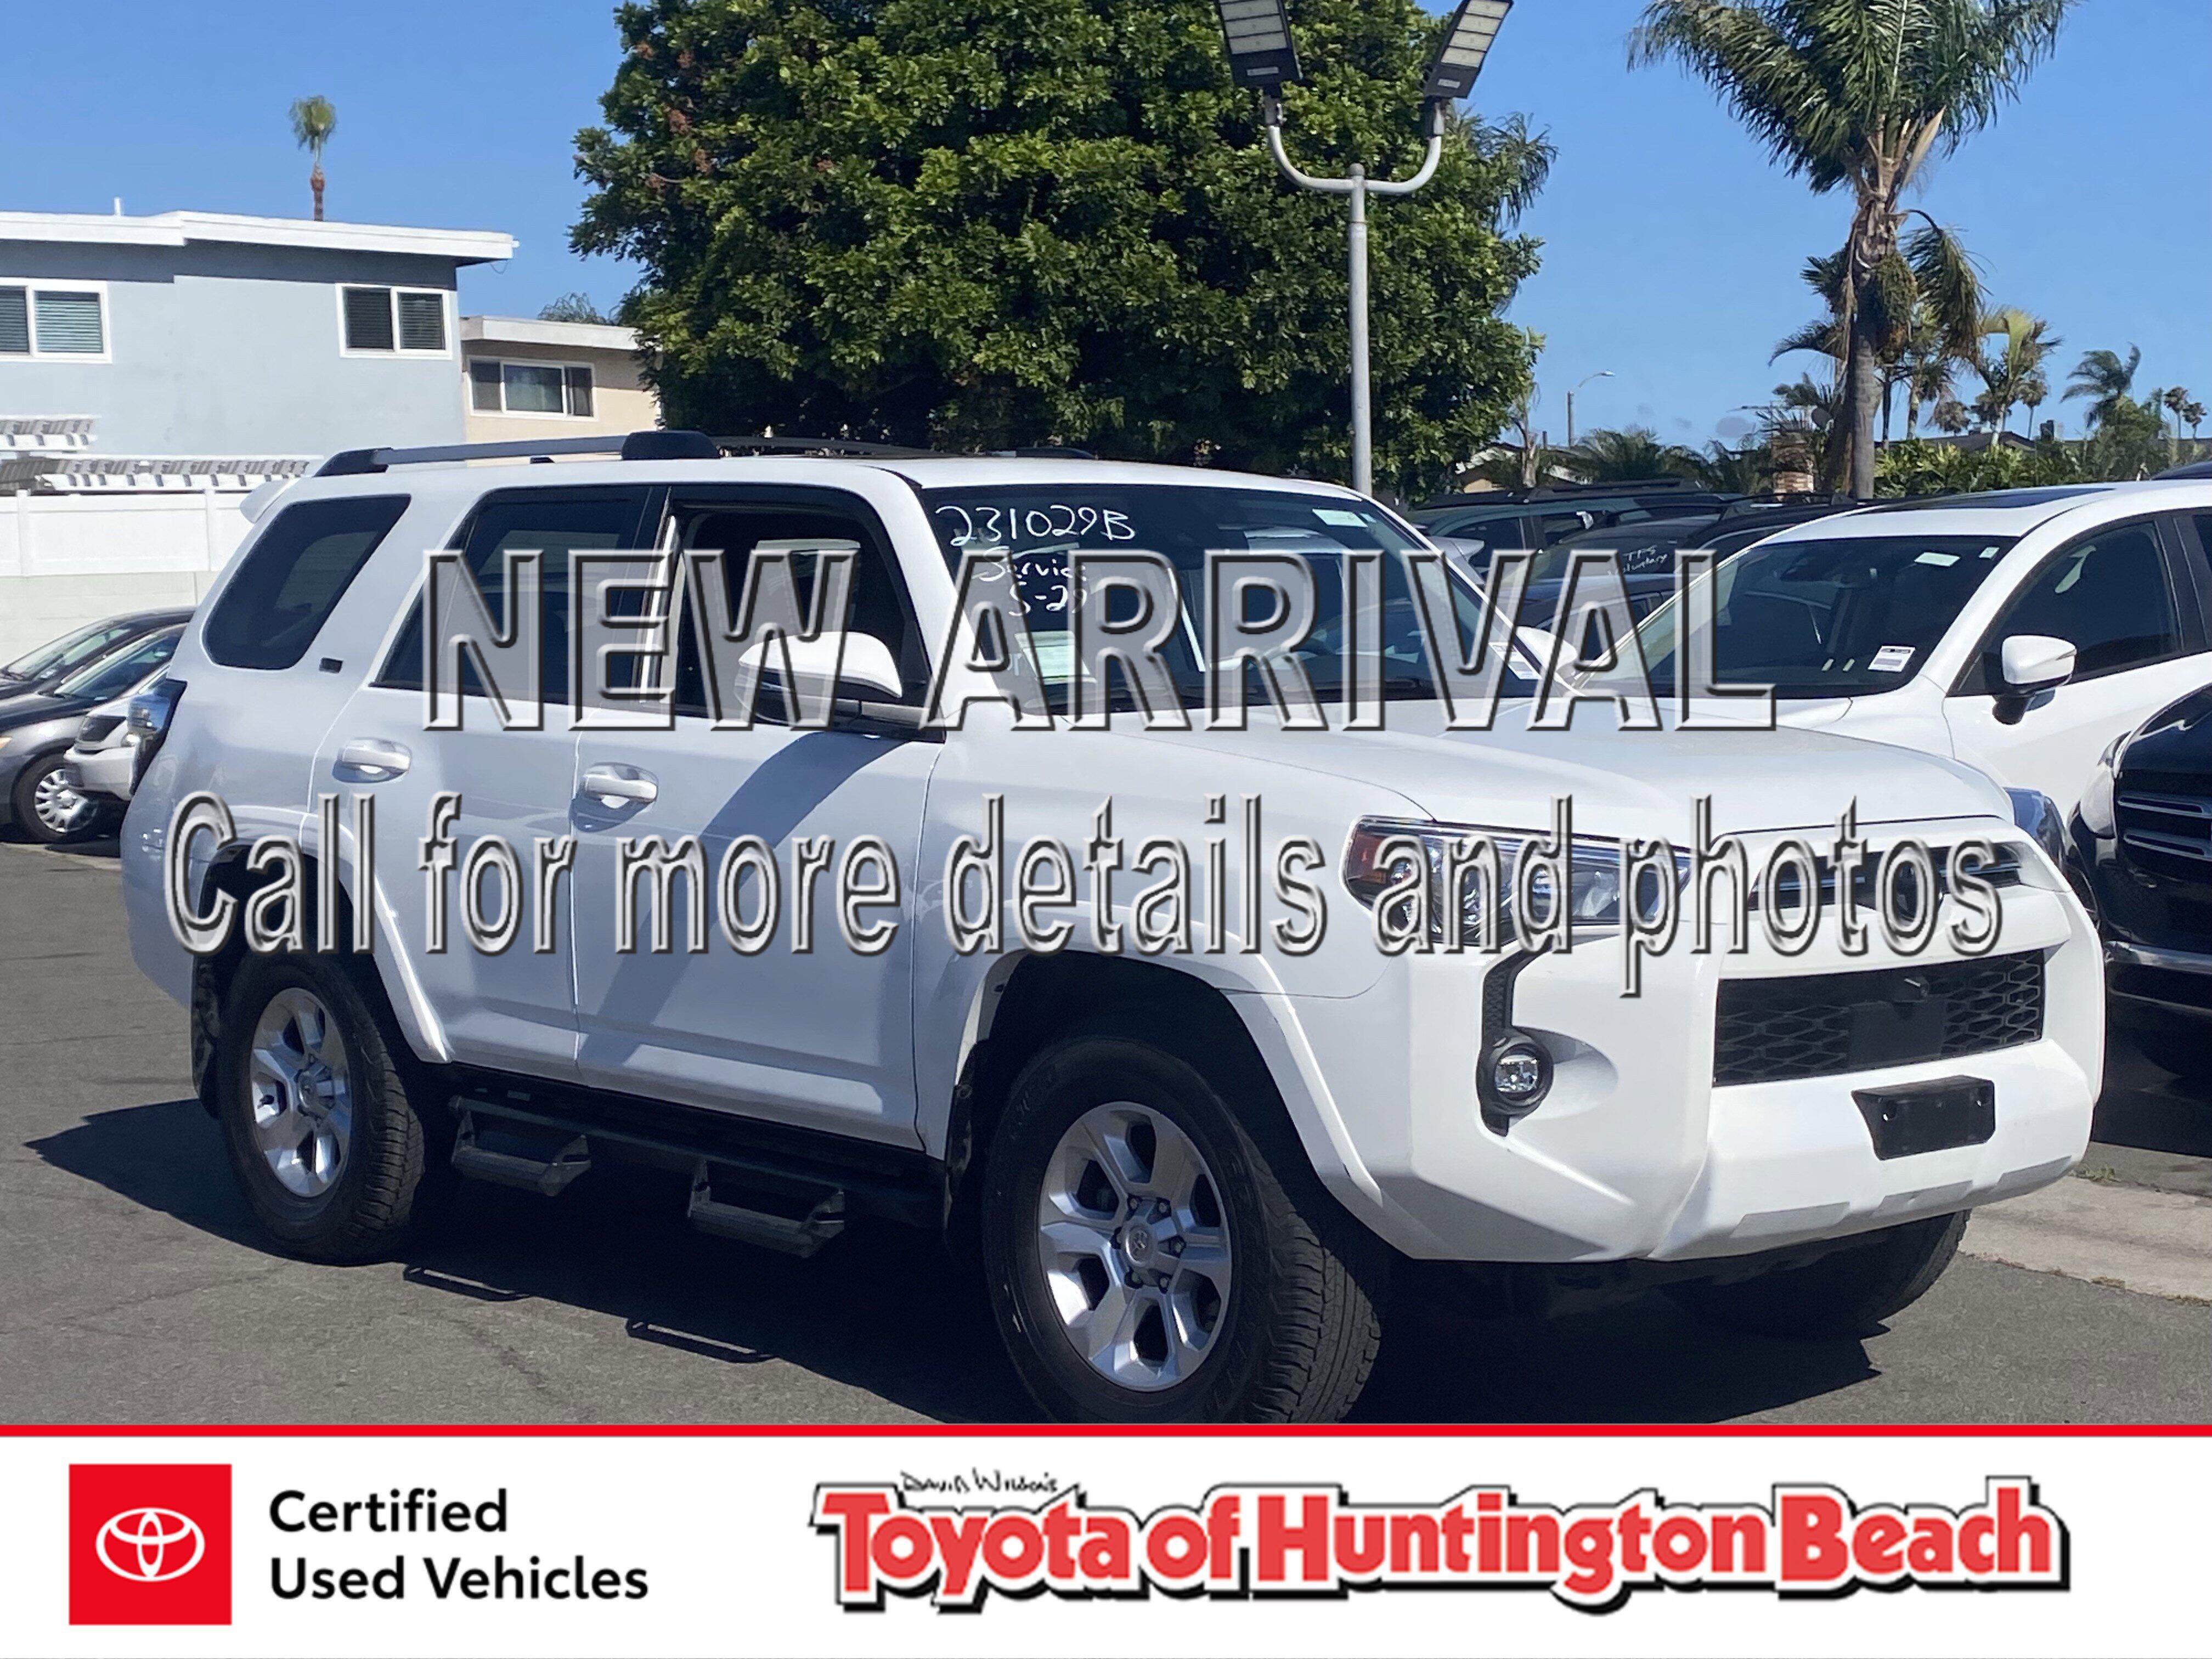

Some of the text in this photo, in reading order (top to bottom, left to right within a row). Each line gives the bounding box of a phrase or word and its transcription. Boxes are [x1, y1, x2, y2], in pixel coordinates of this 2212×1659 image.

[935, 504, 1136, 547] 231029B
[970, 545, 1088, 582] Service
[1607, 554, 1668, 575] luntary
